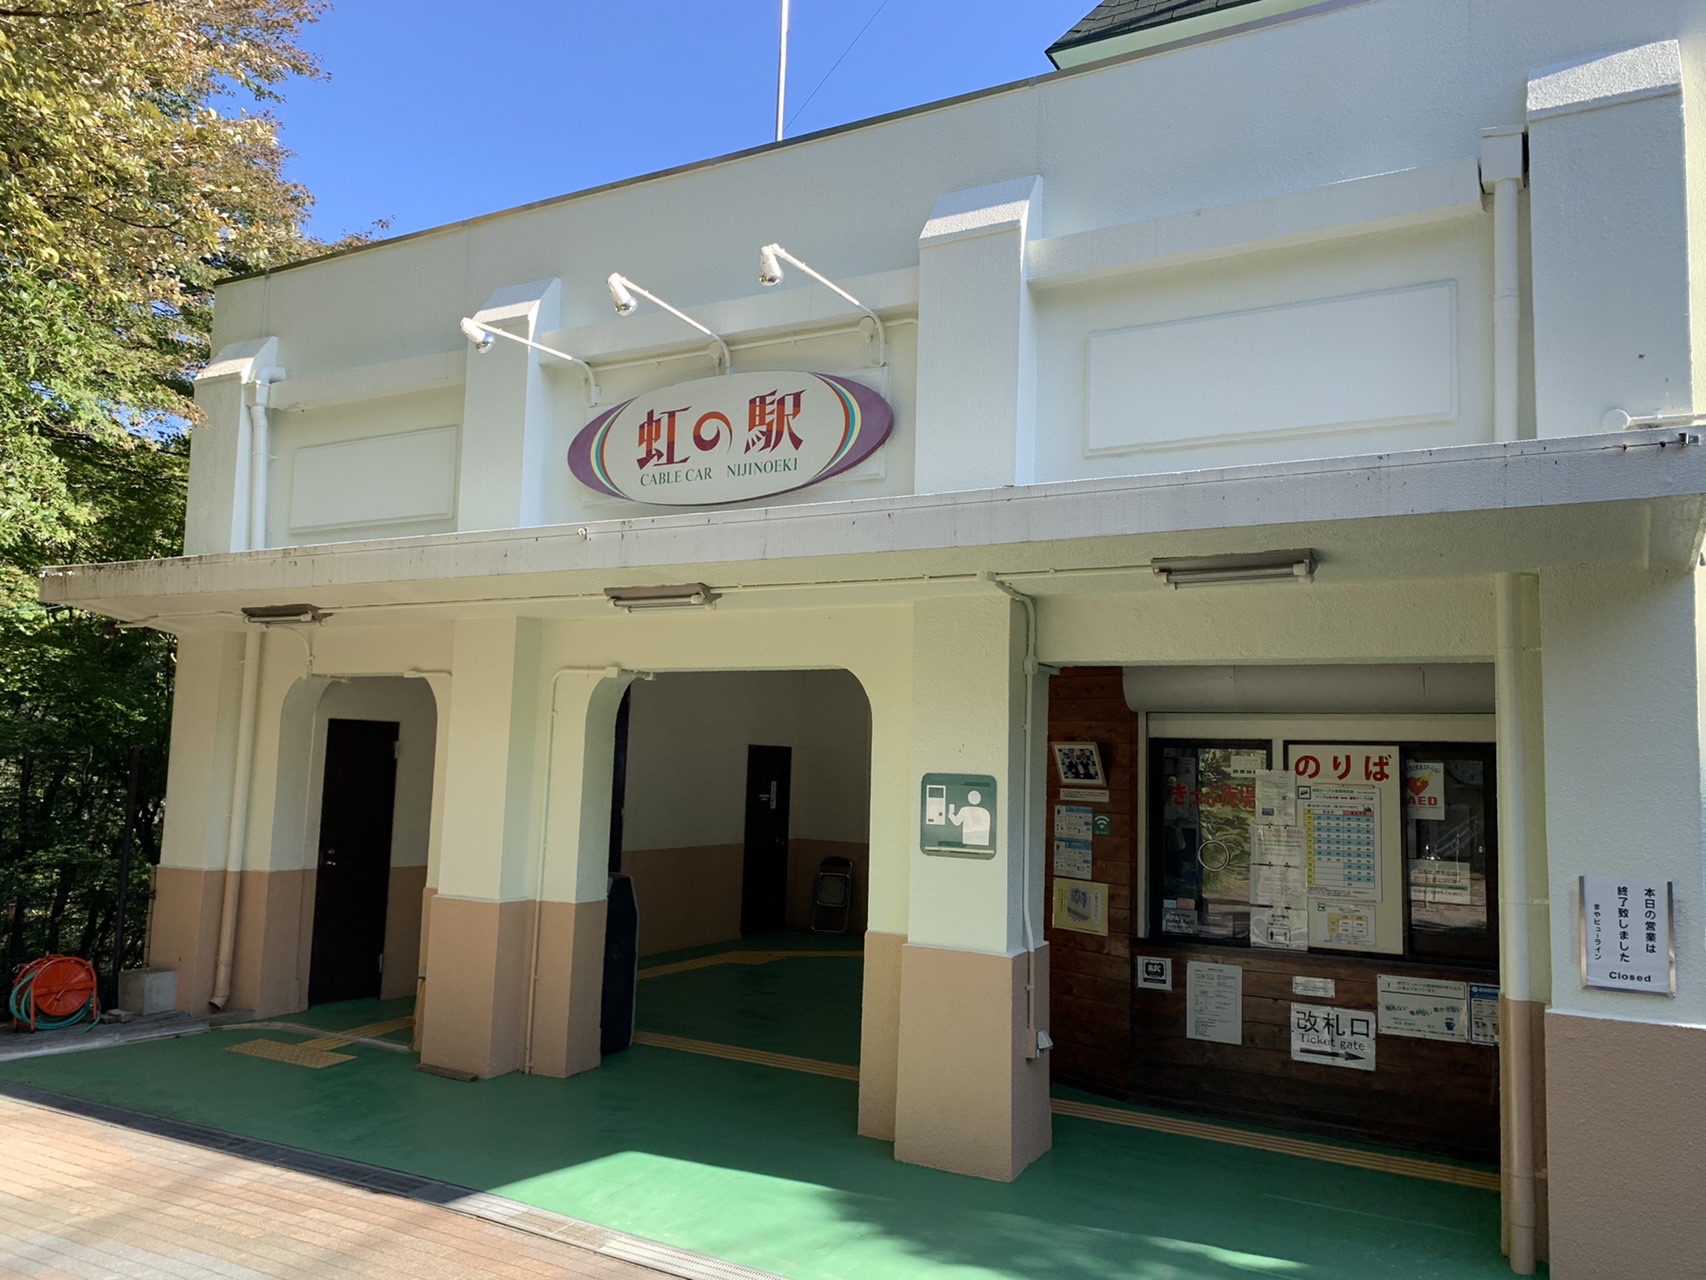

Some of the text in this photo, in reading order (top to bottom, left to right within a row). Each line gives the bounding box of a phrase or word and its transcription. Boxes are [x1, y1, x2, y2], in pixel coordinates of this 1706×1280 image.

[636, 389, 807, 470] 虹の駅
[640, 458, 798, 486] CABLE CAR NIJINOEKI
[1294, 754, 1392, 781] のりば
[1406, 796, 1438, 806] AED
[1617, 886, 1630, 963] 終了致しました
[1644, 888, 1657, 953] 本日の営業は
[1609, 971, 1652, 983] Closed
[1296, 1010, 1369, 1038] 改札口
[1299, 1032, 1365, 1051] Ticket gate
